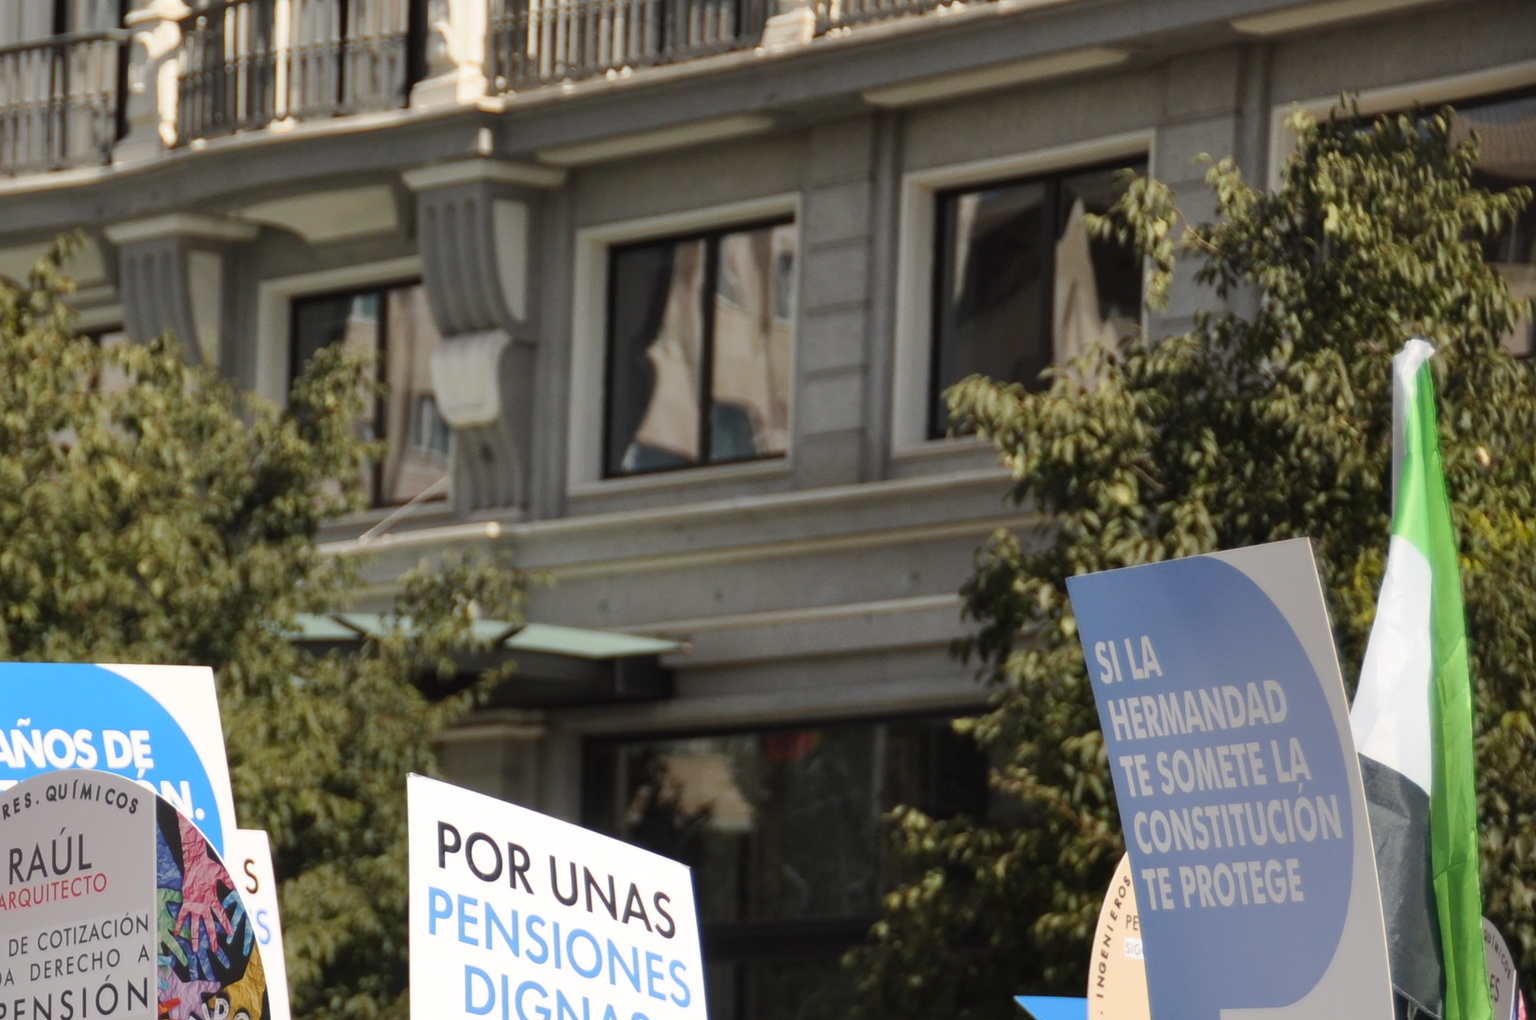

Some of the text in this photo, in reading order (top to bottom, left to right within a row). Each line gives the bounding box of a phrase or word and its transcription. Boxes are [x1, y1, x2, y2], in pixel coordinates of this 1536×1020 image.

[1095, 635, 1163, 684] SI LA
[1108, 680, 1288, 741] HERMANDAD
[102, 730, 154, 769] DE
[1119, 737, 1312, 797] TE SOMETE LA
[45, 779, 138, 814] QUÍMICOS
[1134, 783, 1343, 854] CONSTITUCIÓN
[9, 827, 92, 885] RAÚL
[438, 820, 676, 939] POR UNAS
[1141, 858, 1304, 910] TE PROTEGE
[8, 936, 28, 957] DE
[37, 912, 150, 951] COTIZACIÓN
[30, 949, 121, 982] DERECHO
[137, 944, 150, 964] A
[428, 886, 691, 1008] PENSIONES
[1096, 874, 1132, 999] INGENIEROS
